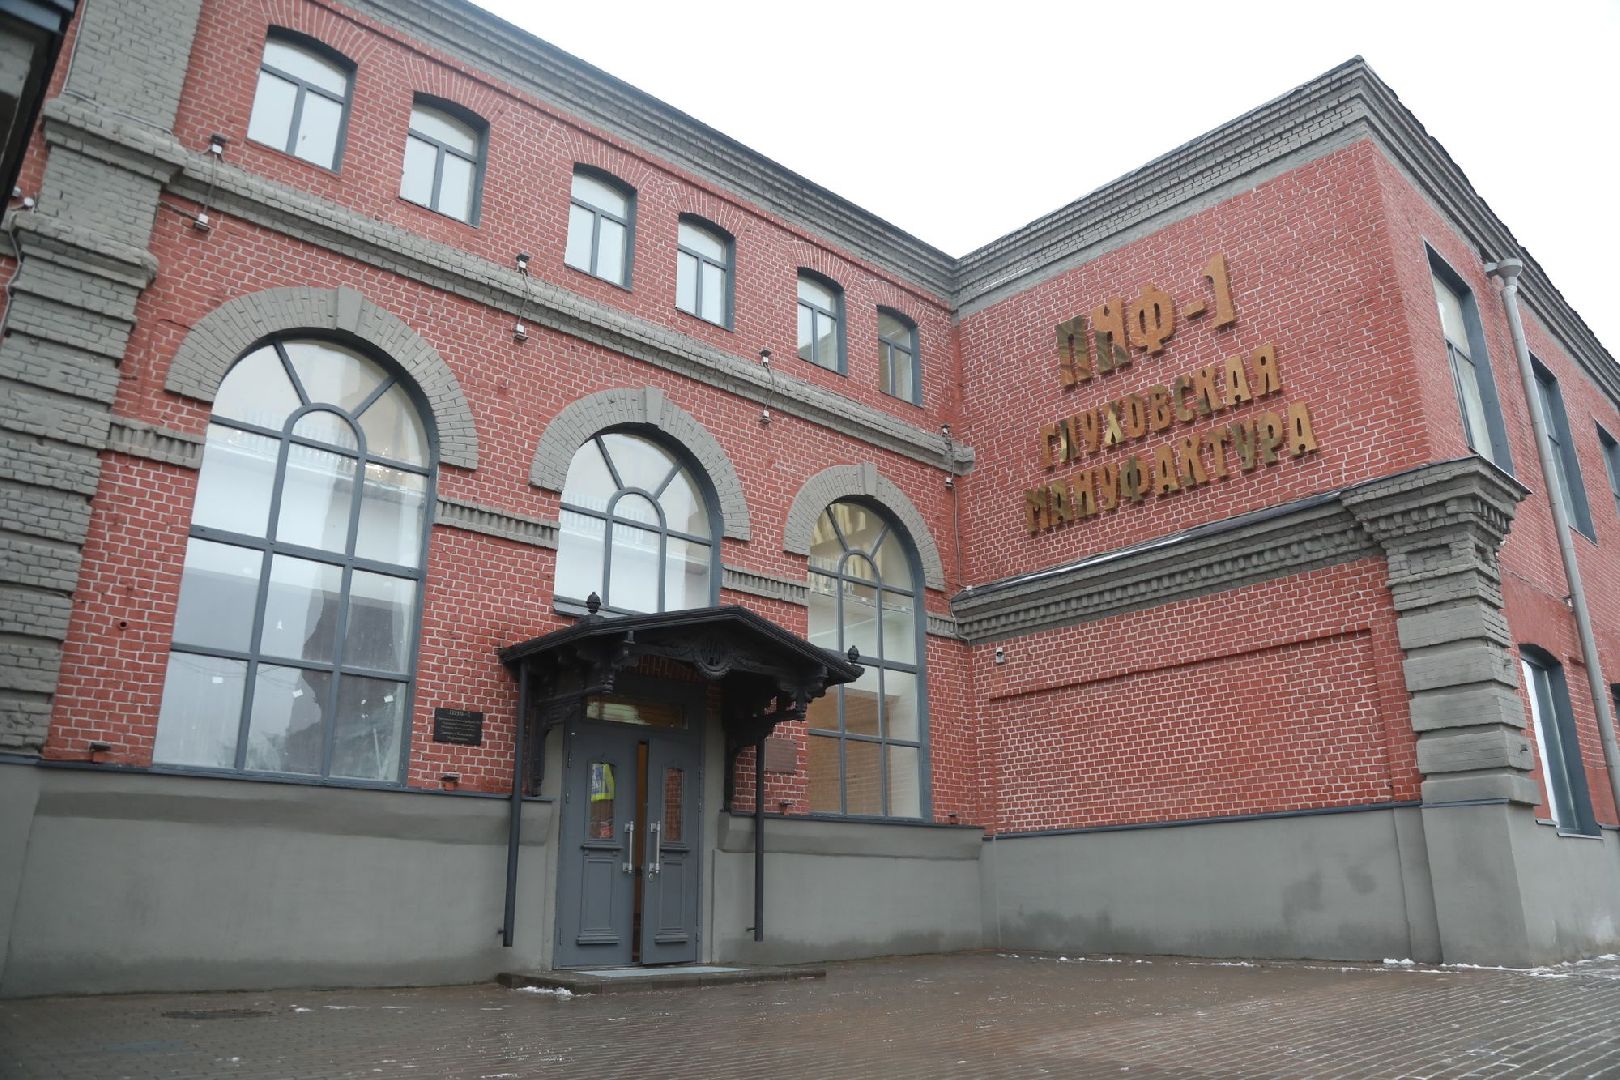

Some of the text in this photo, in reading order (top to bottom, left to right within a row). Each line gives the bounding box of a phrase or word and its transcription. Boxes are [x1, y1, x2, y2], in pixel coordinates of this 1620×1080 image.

[1056, 252, 1236, 388] ПНФ-1
[1025, 401, 1318, 535] МАНУФАКТУРА
[1039, 342, 1282, 470] ГЛУХОВСКАЯ
